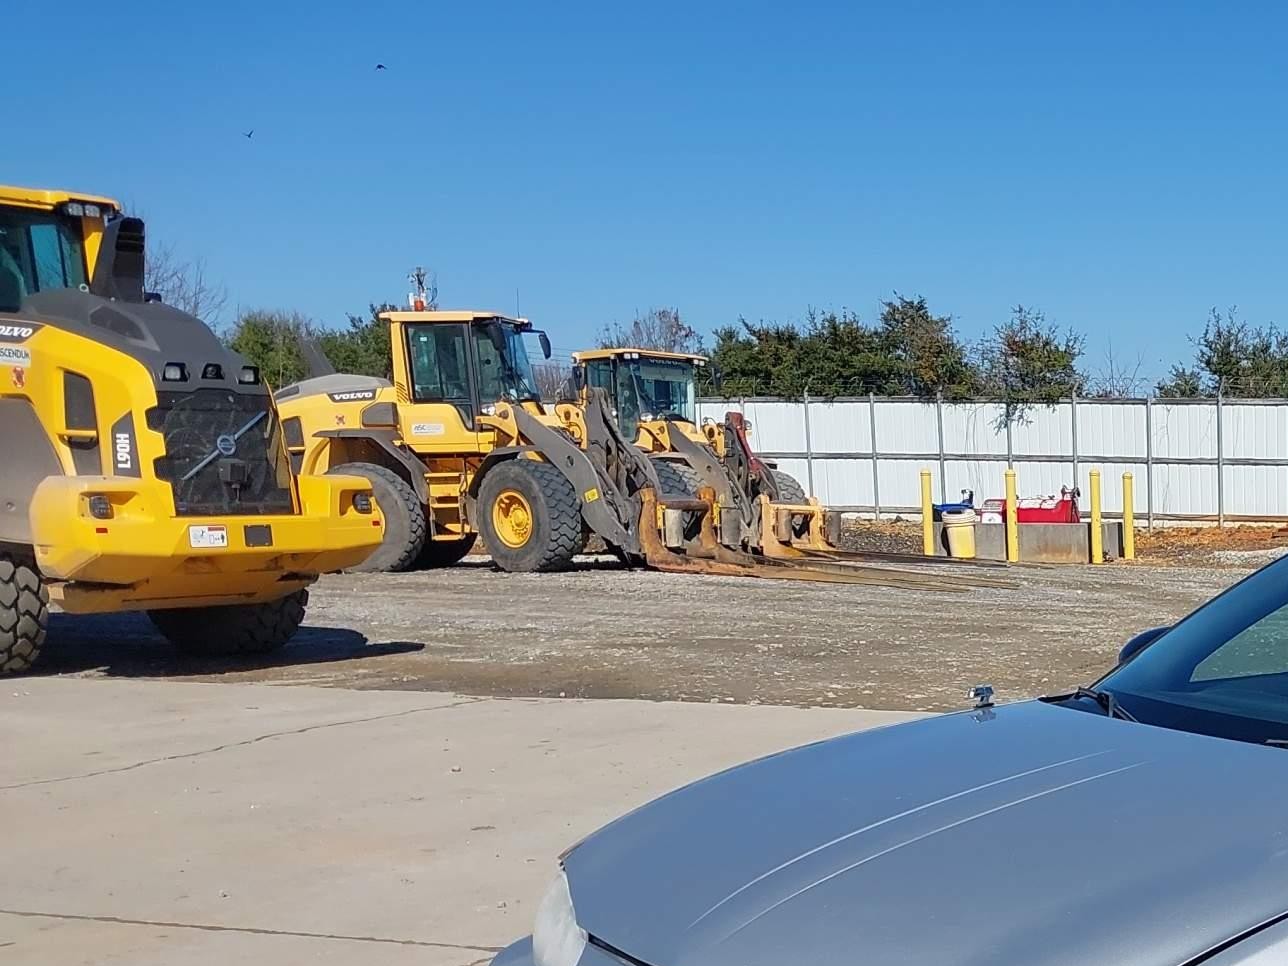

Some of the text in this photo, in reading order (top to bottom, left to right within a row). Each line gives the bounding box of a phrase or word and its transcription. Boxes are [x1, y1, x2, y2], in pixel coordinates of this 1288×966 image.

[0, 325, 32, 337] OLVO
[333, 391, 373, 400] VOLVO
[115, 433, 131, 468] L90H
